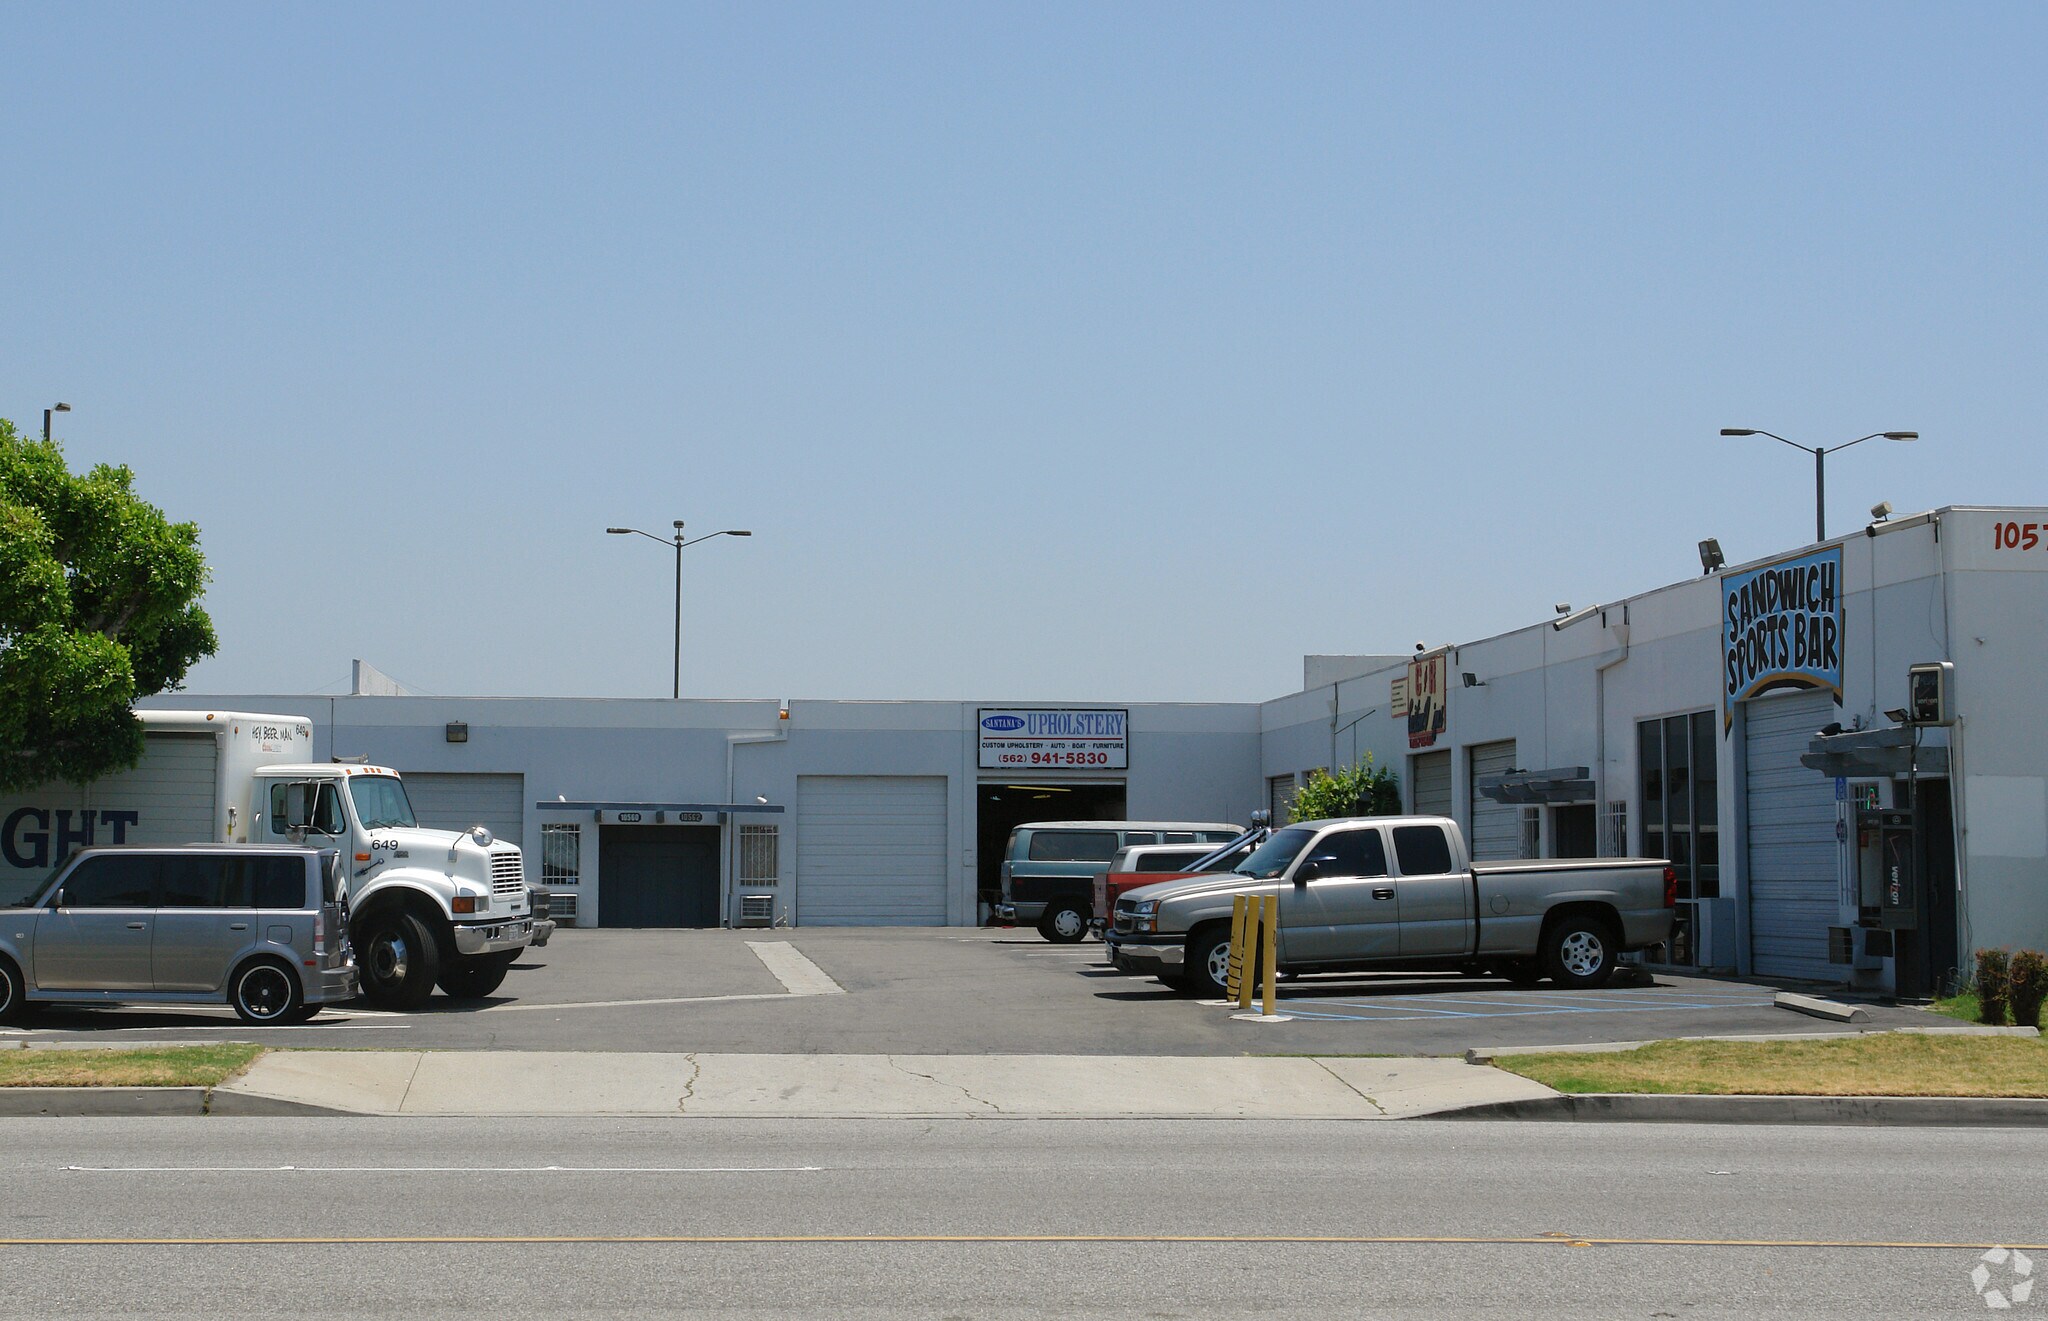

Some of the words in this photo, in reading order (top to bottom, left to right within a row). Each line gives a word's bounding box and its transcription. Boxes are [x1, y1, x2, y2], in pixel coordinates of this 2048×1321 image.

[1728, 561, 1835, 643] SANDWICH
[1727, 614, 1789, 696] SPORTS
[1794, 612, 1838, 671] BAR
[985, 718, 1022, 728] SANTANA'S
[1027, 713, 1124, 736] UPHOLSTERY
[998, 754, 1027, 763] (562)
[1031, 752, 1108, 764] 941-5830
[372, 839, 399, 850] 649
[1890, 866, 1901, 905] verizon
